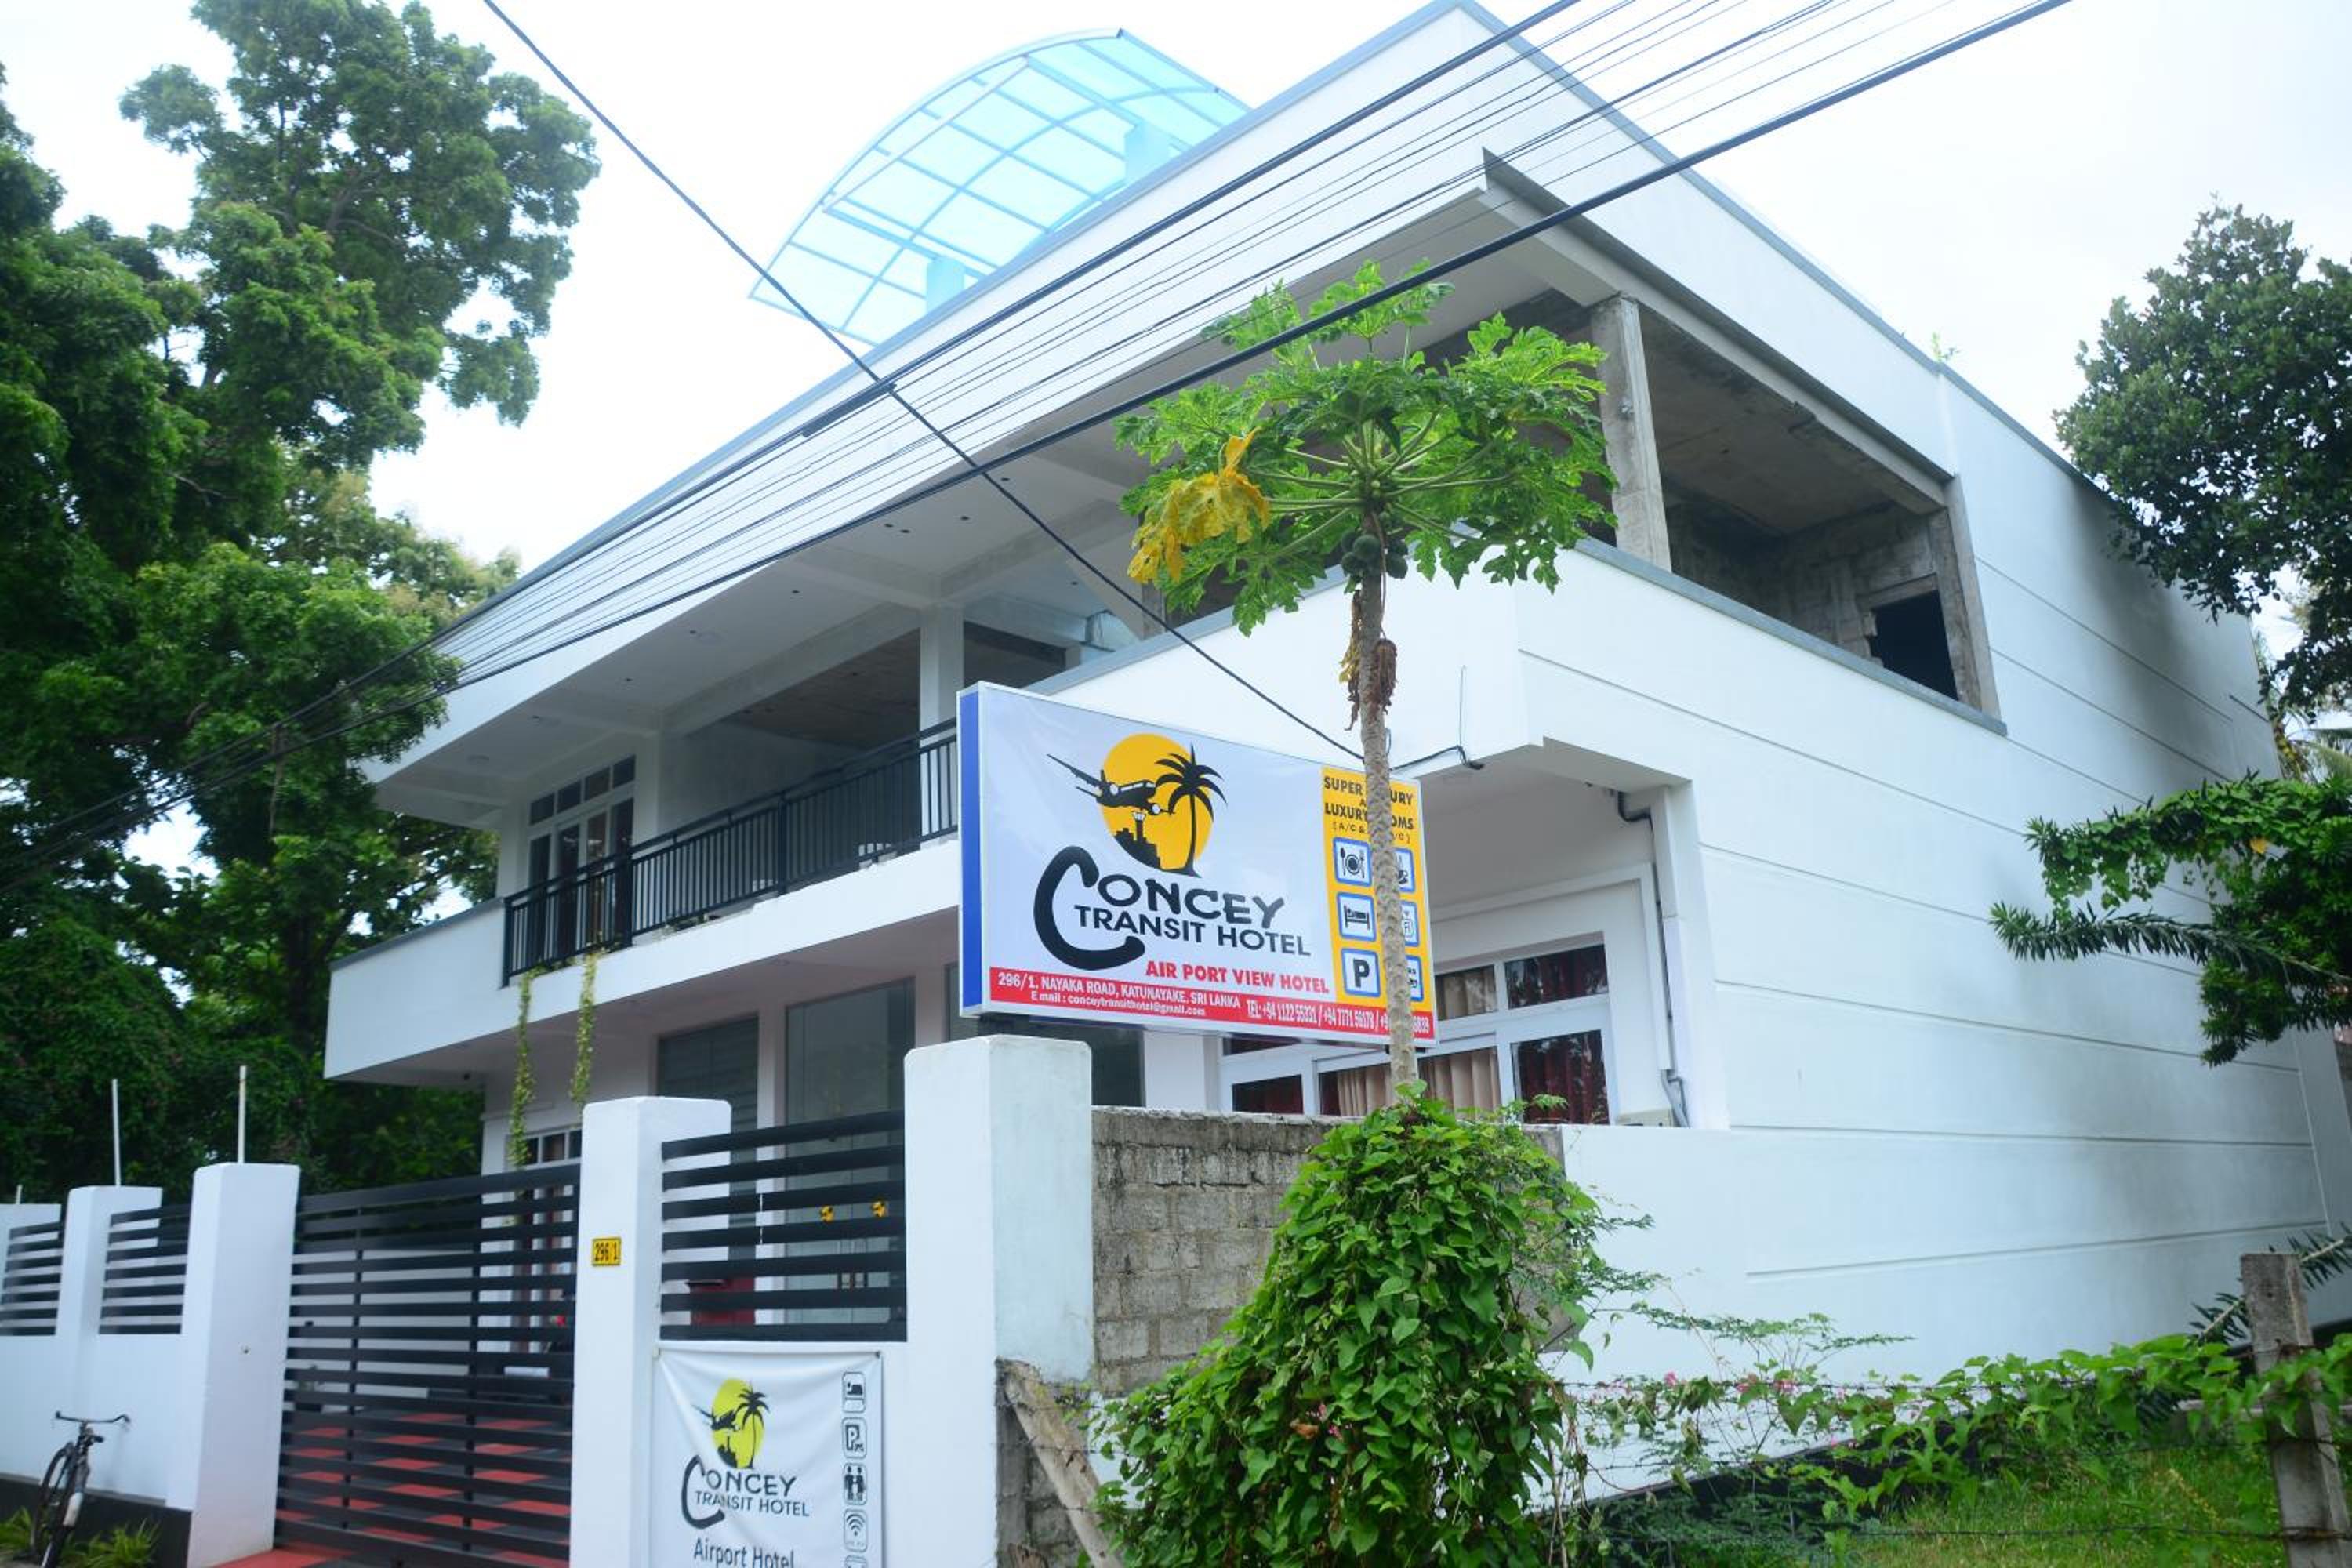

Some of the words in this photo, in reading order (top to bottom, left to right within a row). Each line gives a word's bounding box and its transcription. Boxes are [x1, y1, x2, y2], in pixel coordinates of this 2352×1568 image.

[1324, 776, 1363, 796] SUPER
[1389, 789, 1414, 806] URY
[1324, 802, 1368, 822] LUXURY
[1033, 846, 1285, 971] CONCEY
[1074, 904, 1206, 943] TRANSIT
[1217, 926, 1312, 956] HOTEL
[1040, 977, 1083, 993] NAYAKA
[1086, 980, 1120, 997] ROAD,
[1191, 992, 1207, 1005] SRI
[1209, 993, 1240, 1009] LANKA
[1145, 960, 1177, 978] AIR
[1182, 963, 1226, 983] PORT
[1232, 968, 1275, 989] VIEW
[1279, 974, 1330, 994] HOTEL
[681, 1454, 797, 1529] CONCEY
[695, 1490, 753, 1511] TRANSIT
[759, 1498, 810, 1517] HOTEL
[694, 1537, 747, 1568] Airport
[752, 1547, 794, 1568] Hotel
